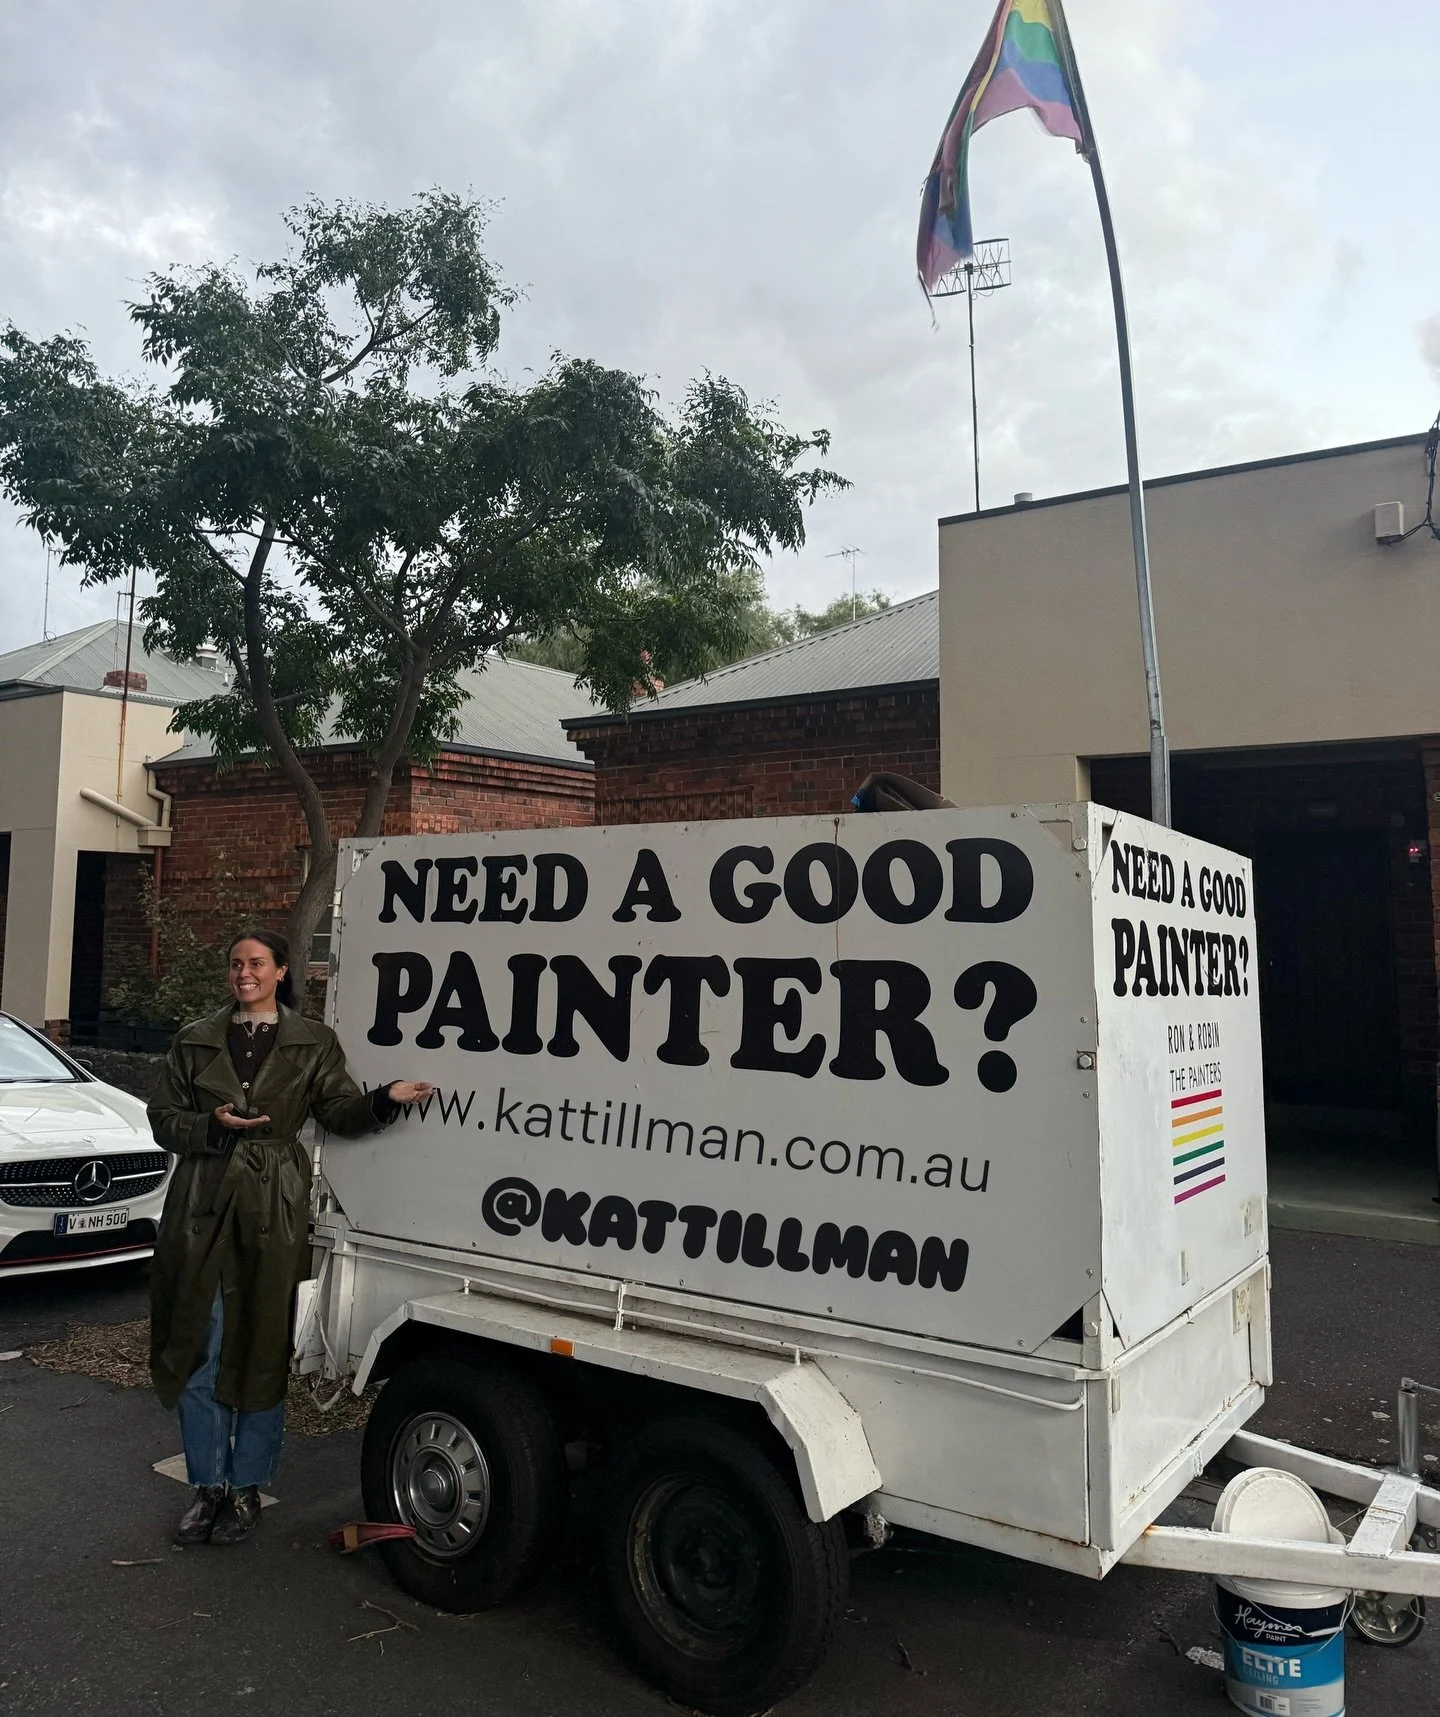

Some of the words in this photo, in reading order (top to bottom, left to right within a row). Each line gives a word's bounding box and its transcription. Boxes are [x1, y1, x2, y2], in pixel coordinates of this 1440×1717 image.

[377, 852, 589, 925] NEED
[611, 848, 682, 923] A
[708, 837, 1034, 926] GOOD
[1110, 839, 1175, 904] NEED
[1181, 860, 1195, 908] A
[1199, 866, 1246, 918] GOOD
[1111, 917, 1249, 998] PAINTER?
[366, 950, 1038, 1095] PAINTER?
[1167, 1024, 1186, 1055] RON
[1188, 1023, 1195, 1052] &
[1197, 1021, 1220, 1051] ROBIN
[1169, 1067, 1186, 1093] THE
[1188, 1061, 1222, 1089] PAINTERS
[361, 1080, 991, 1194] ww.kattillman.com.au
[106, 1212, 127, 1226] 500
[481, 1176, 970, 1293] @KATTILLMAN
[1242, 1648, 1301, 1678] ELITE
[1265, 1633, 1286, 1643] PAINT
